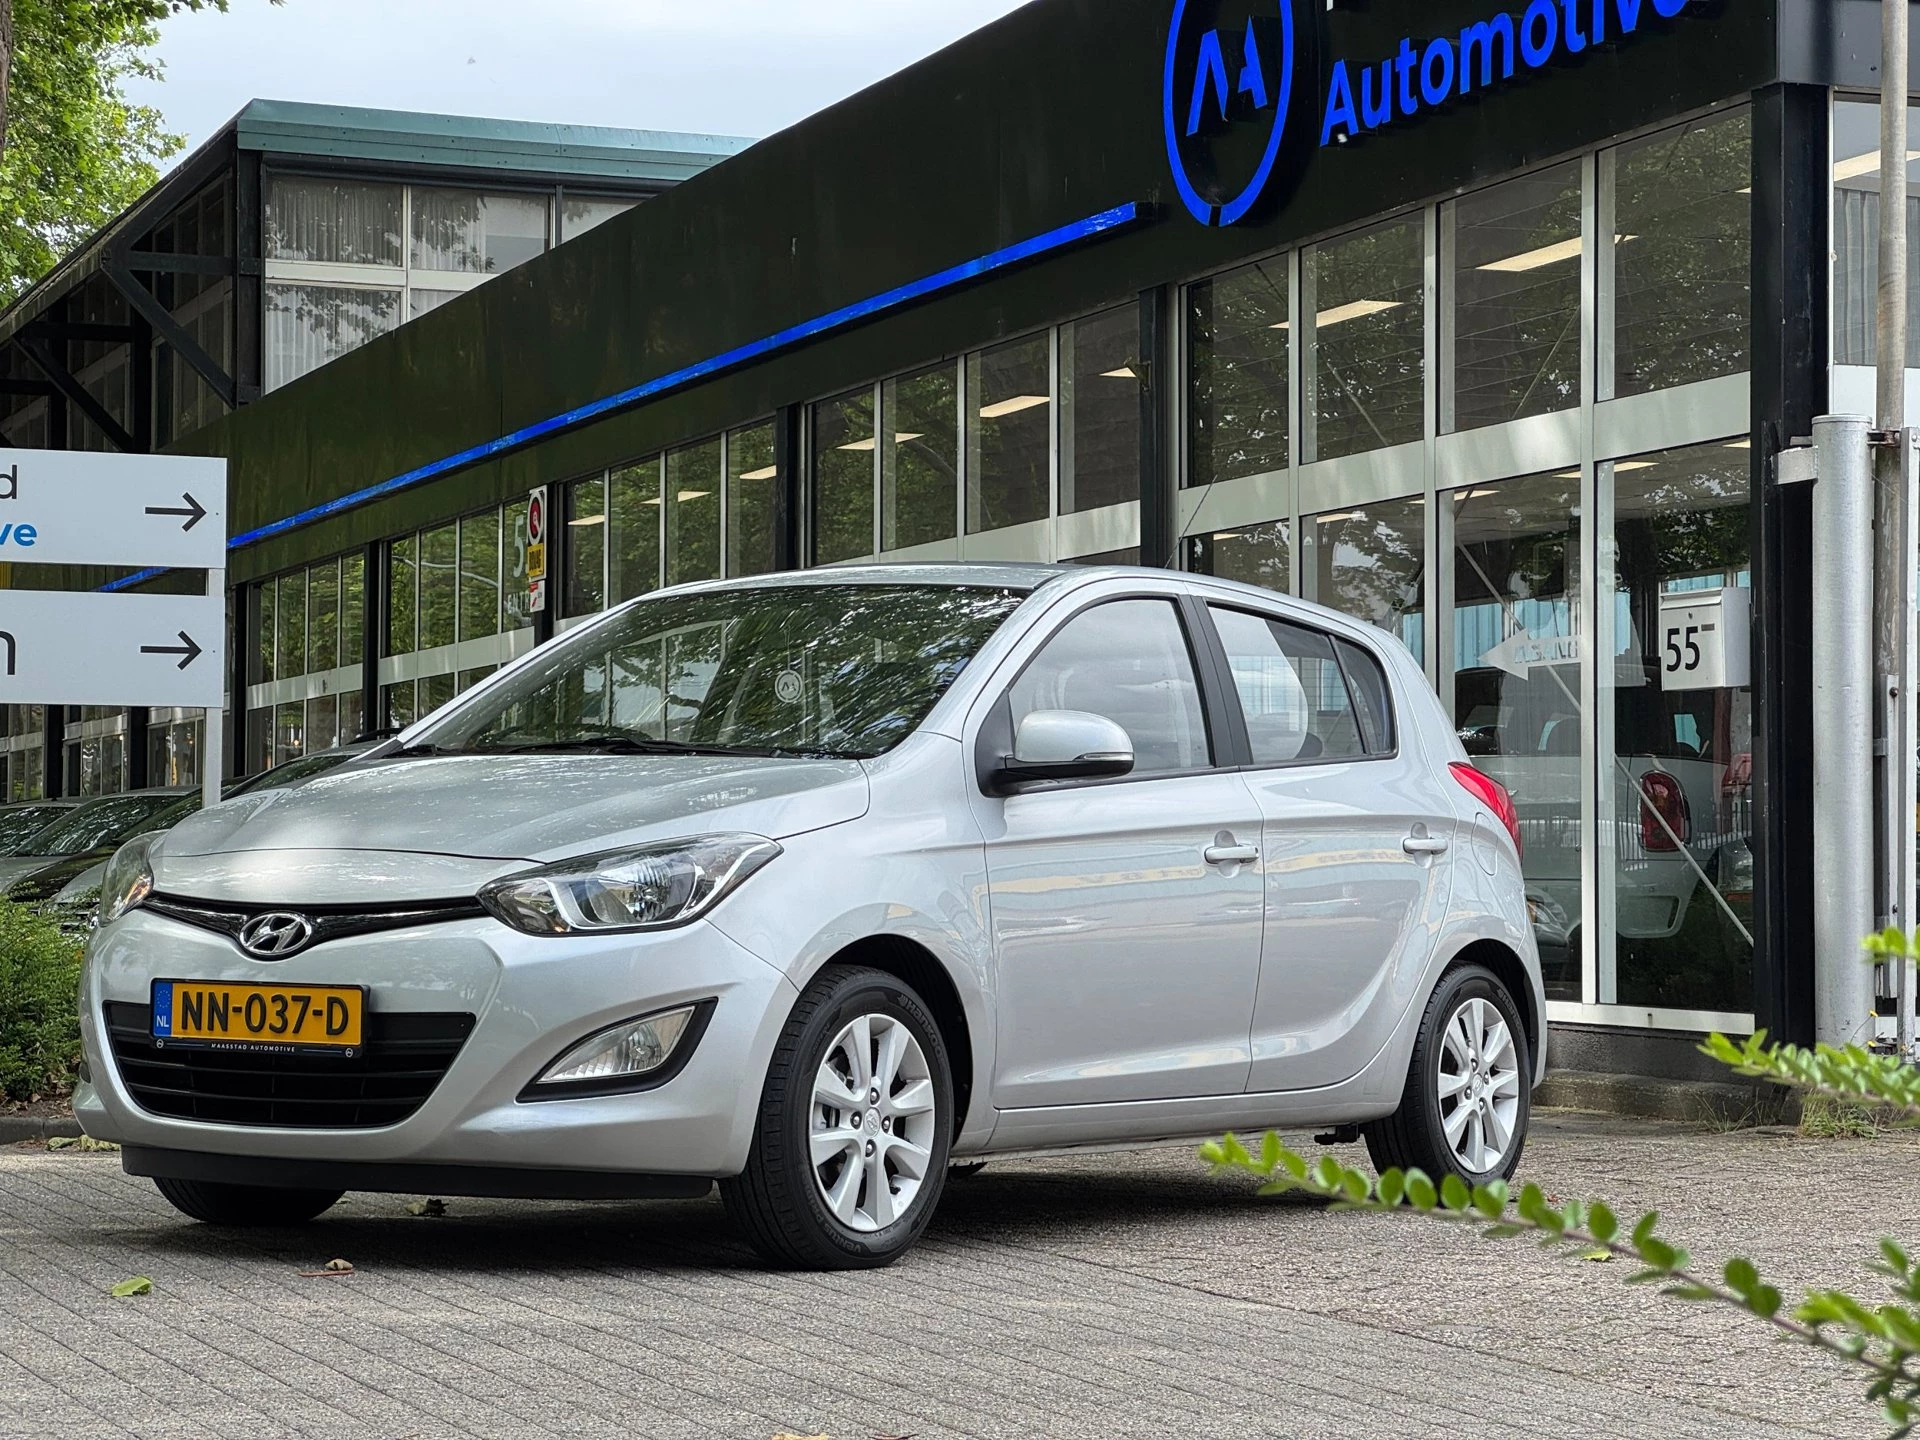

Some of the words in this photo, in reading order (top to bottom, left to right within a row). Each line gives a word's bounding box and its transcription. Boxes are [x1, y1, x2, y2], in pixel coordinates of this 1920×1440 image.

[1320, 0, 1688, 147] Automotiv
[1666, 626, 1701, 672] 55
[156, 1014, 170, 1028] NL
[181, 990, 349, 1036] NN-037-D
[250, 1044, 295, 1053] AUTOMOTIVE
